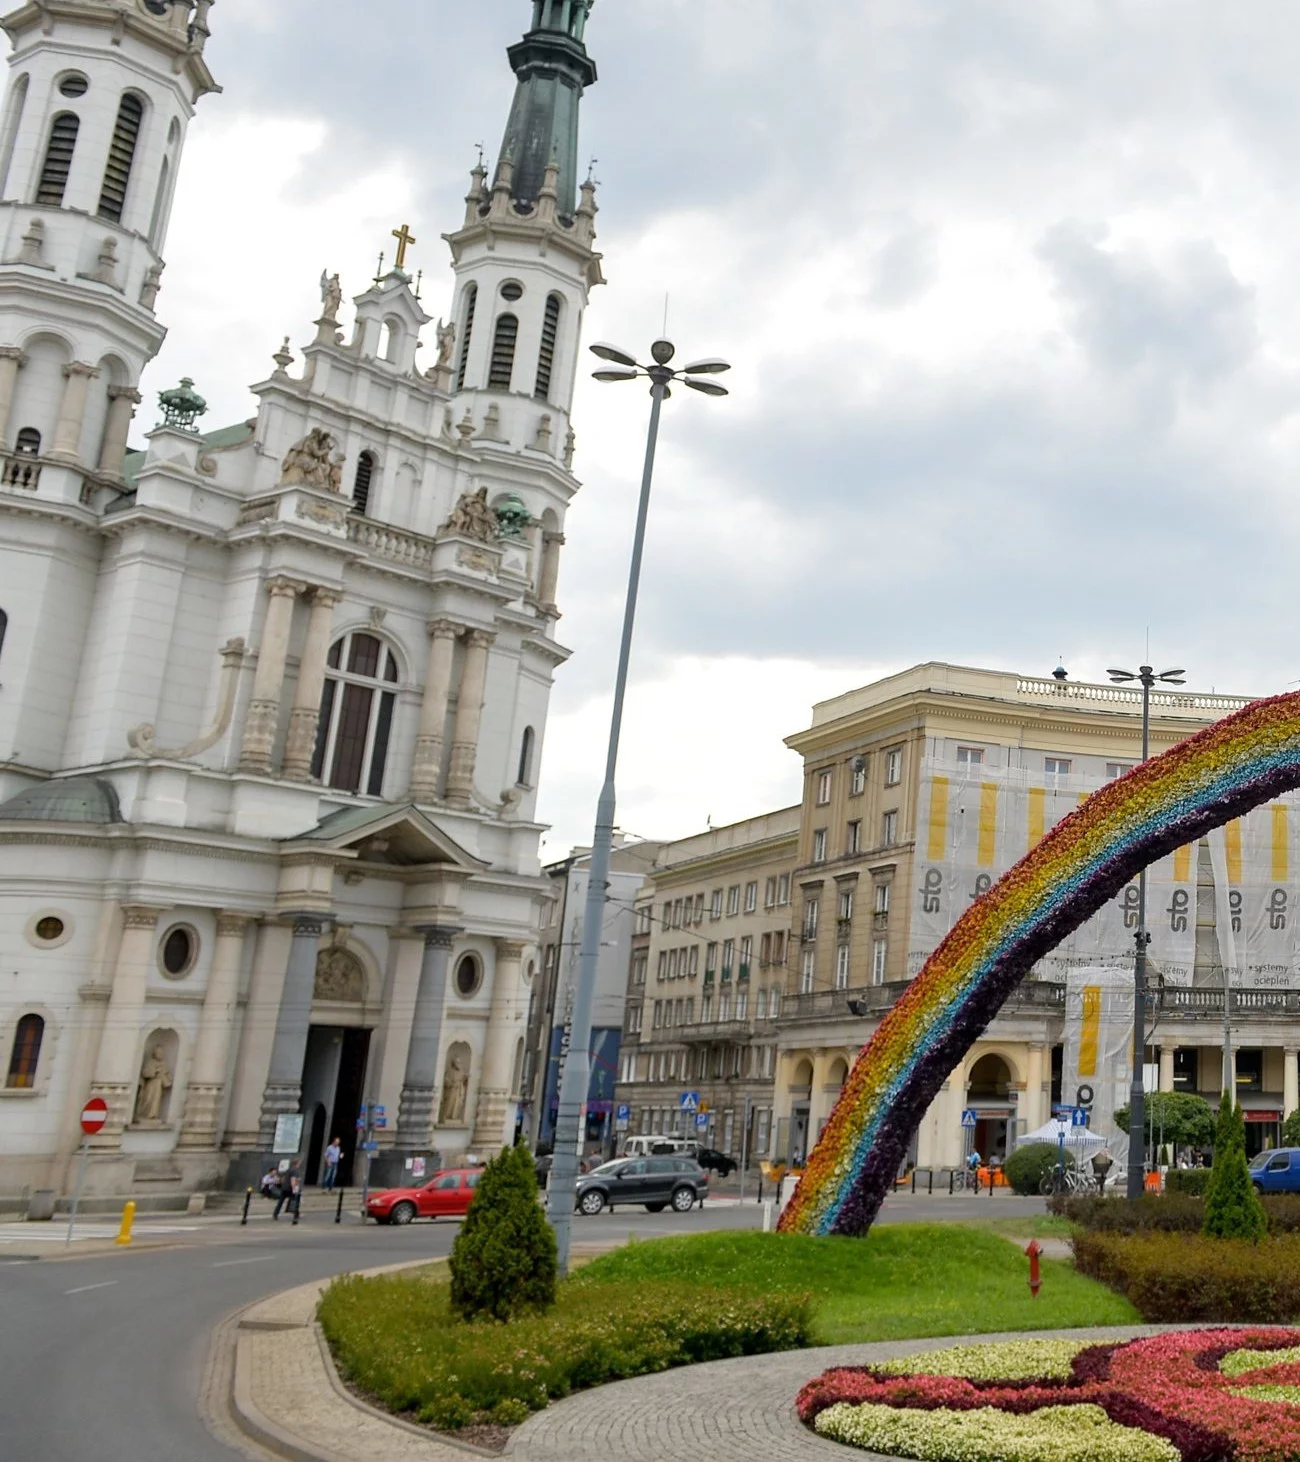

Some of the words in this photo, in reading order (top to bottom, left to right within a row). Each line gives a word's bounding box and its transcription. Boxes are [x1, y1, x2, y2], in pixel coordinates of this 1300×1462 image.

[919, 868, 942, 914] sto
[1166, 889, 1189, 933] sto
[1265, 888, 1287, 930] sto
[1254, 964, 1288, 973] systemy
